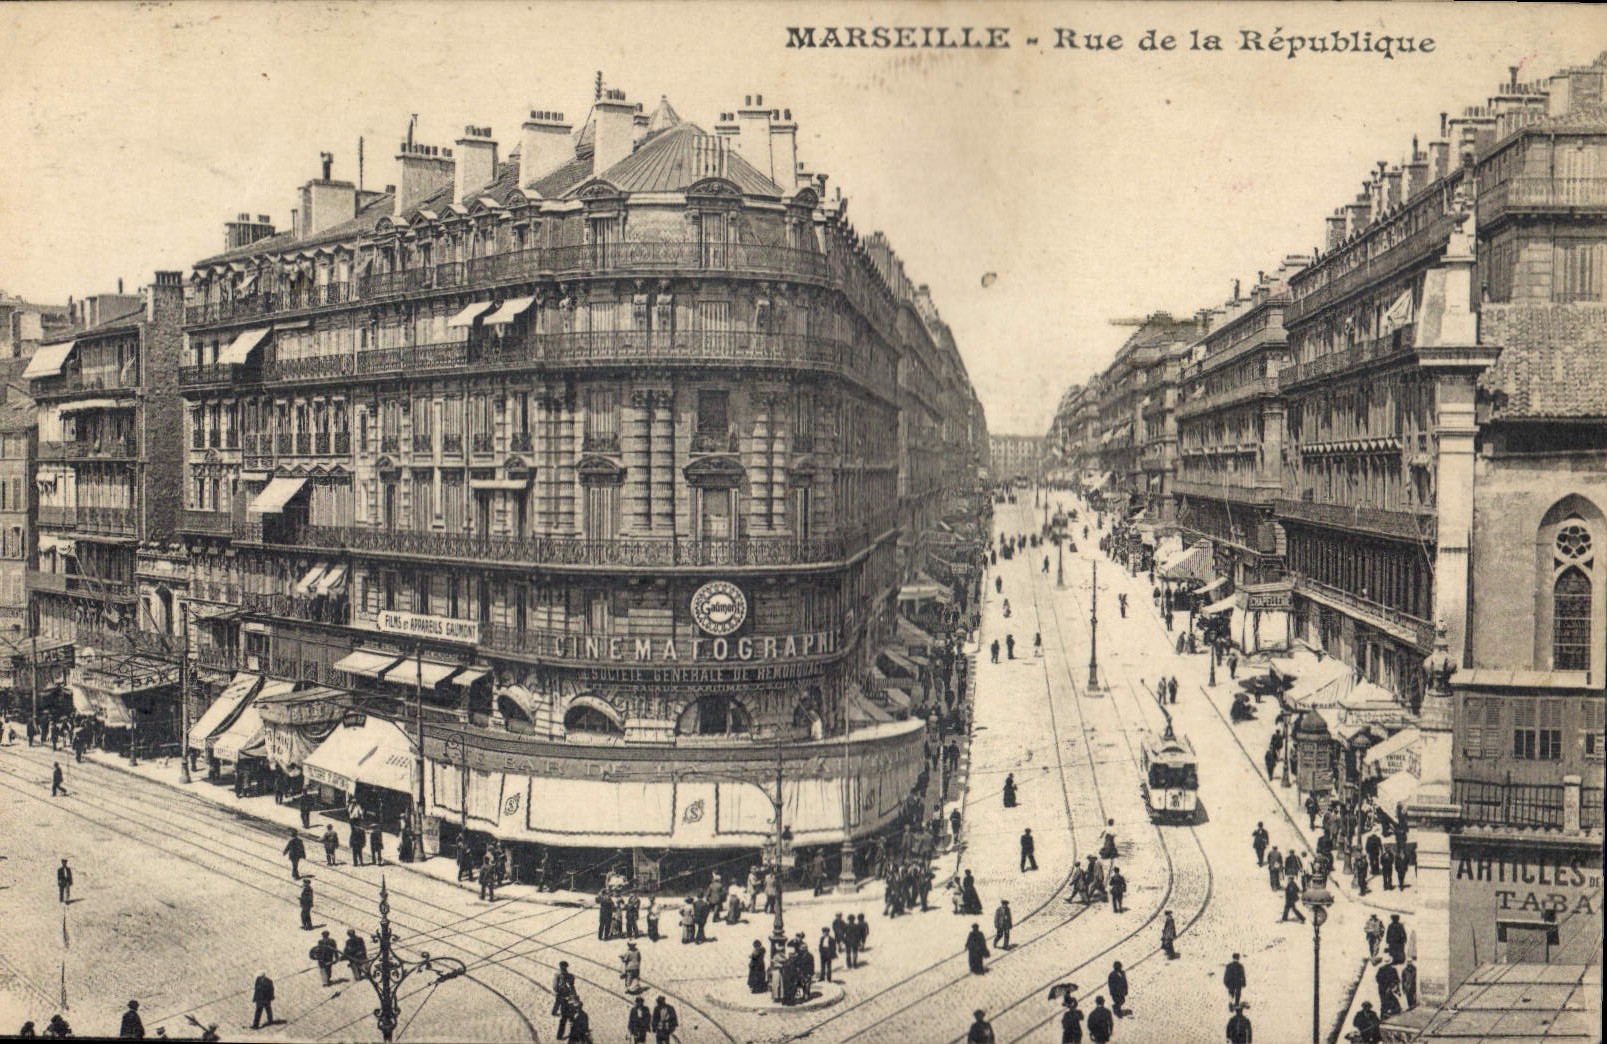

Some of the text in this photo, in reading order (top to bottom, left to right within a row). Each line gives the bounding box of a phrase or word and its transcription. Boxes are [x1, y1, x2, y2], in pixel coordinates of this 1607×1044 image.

[385, 614, 402, 629] FILMS
[410, 617, 443, 635] APPAREILS
[446, 621, 476, 639] GAUMONT
[733, 666, 750, 681] DE
[503, 756, 566, 776] BAR
[1456, 858, 1586, 887] ARTICLES
